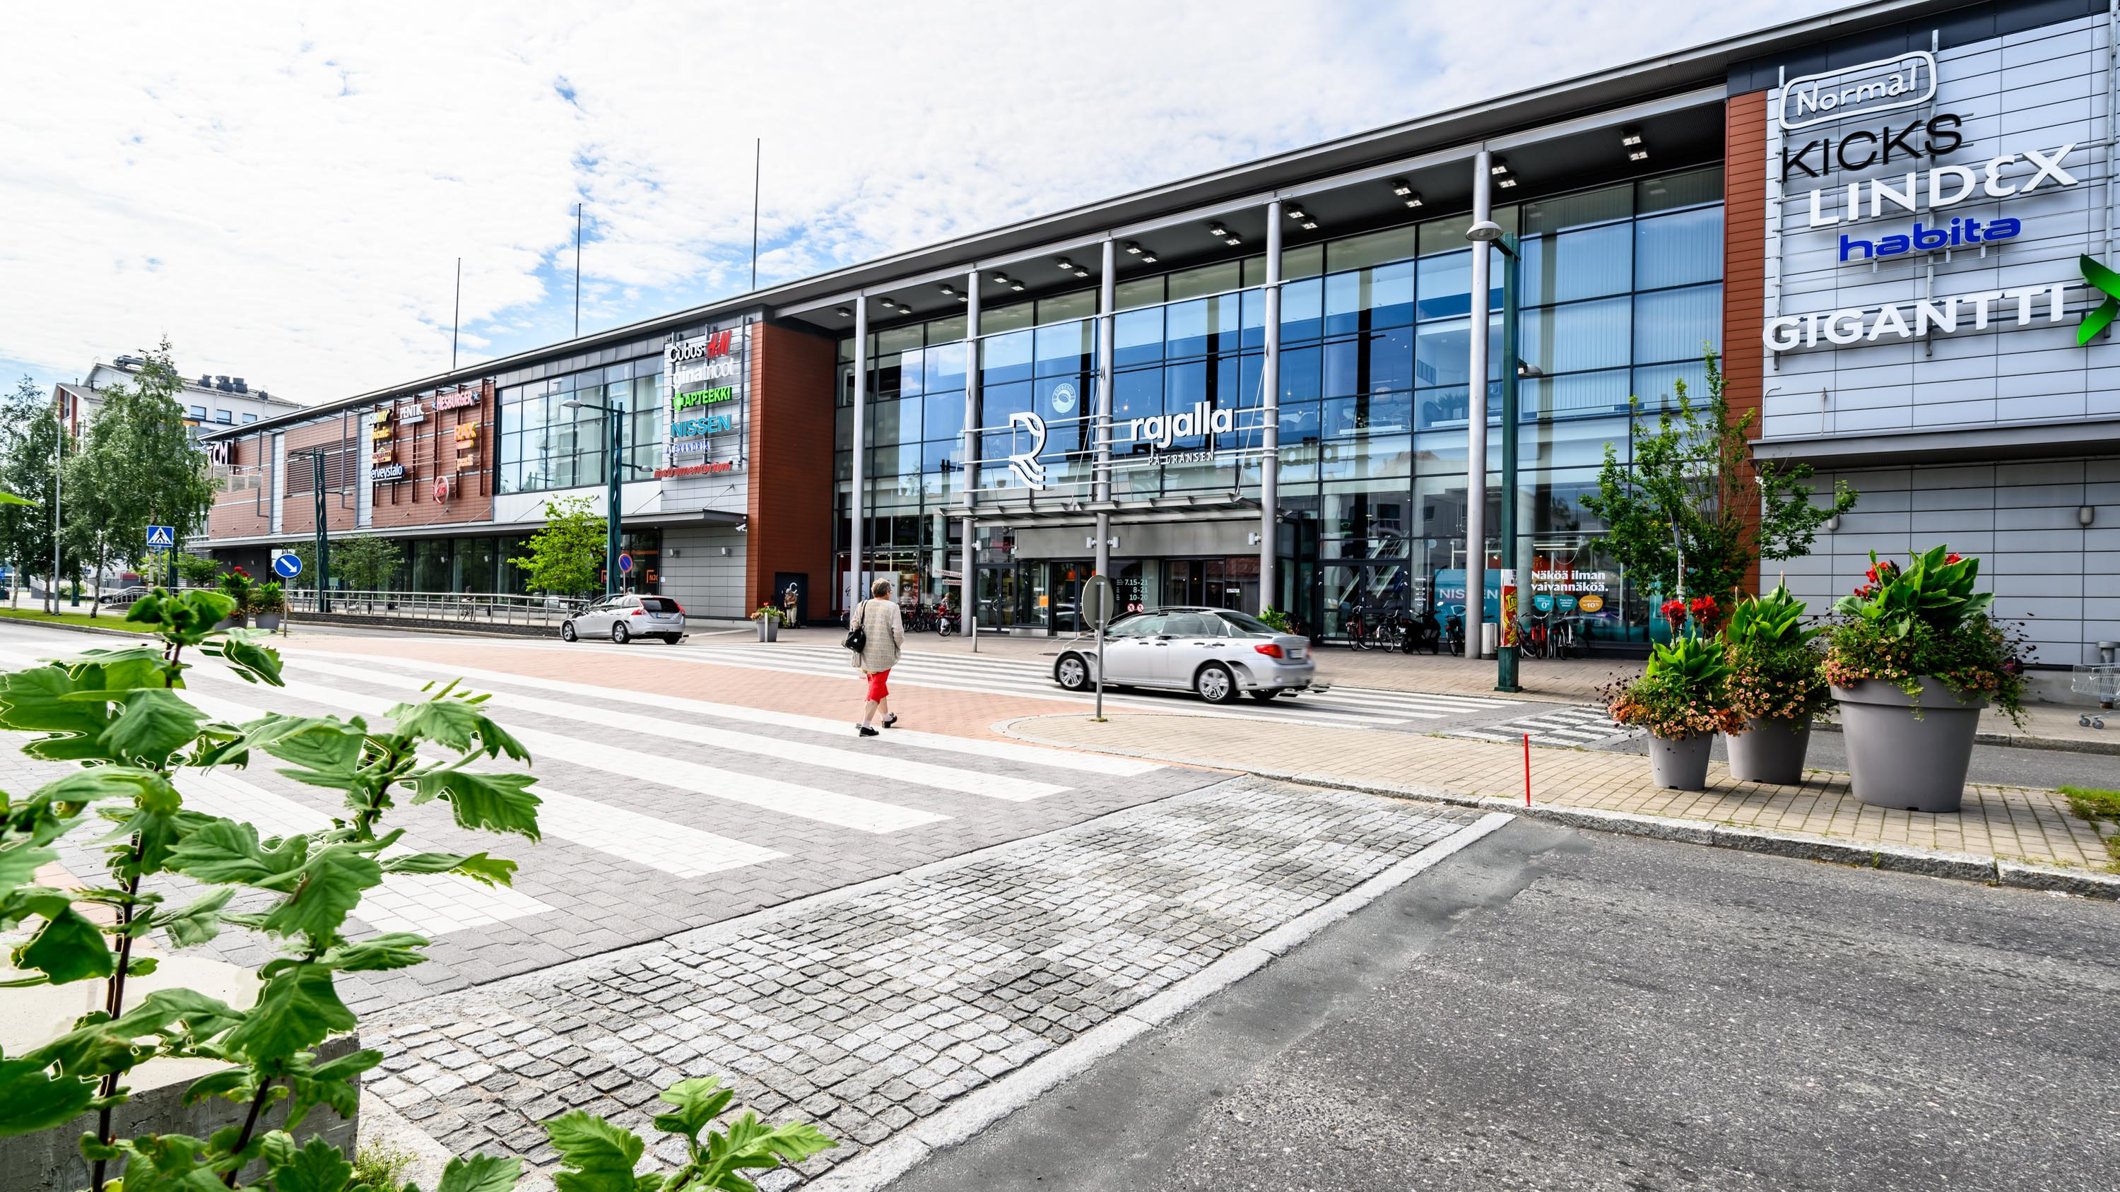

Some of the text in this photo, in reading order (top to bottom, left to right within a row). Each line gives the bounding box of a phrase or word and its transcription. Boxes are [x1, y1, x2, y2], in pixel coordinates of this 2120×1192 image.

[1797, 64, 1917, 116] Normal
[1782, 113, 1963, 182] KICKS
[1809, 143, 2079, 228] LINDEX
[1839, 217, 2022, 262] habita
[1762, 283, 2065, 352] GIGANTTI
[437, 391, 473, 412] HESBURGER
[683, 387, 733, 408] APTEEKKI
[671, 415, 732, 439] NISSEN
[1130, 400, 1234, 449] rajalla
[368, 463, 402, 481] erveystalo
[1124, 578, 1148, 586] 7.15-21
[1531, 569, 1606, 580] Näköä ilman
[1438, 589, 1499, 600] NISEN
[1531, 581, 1609, 593] vaivannäköä.
